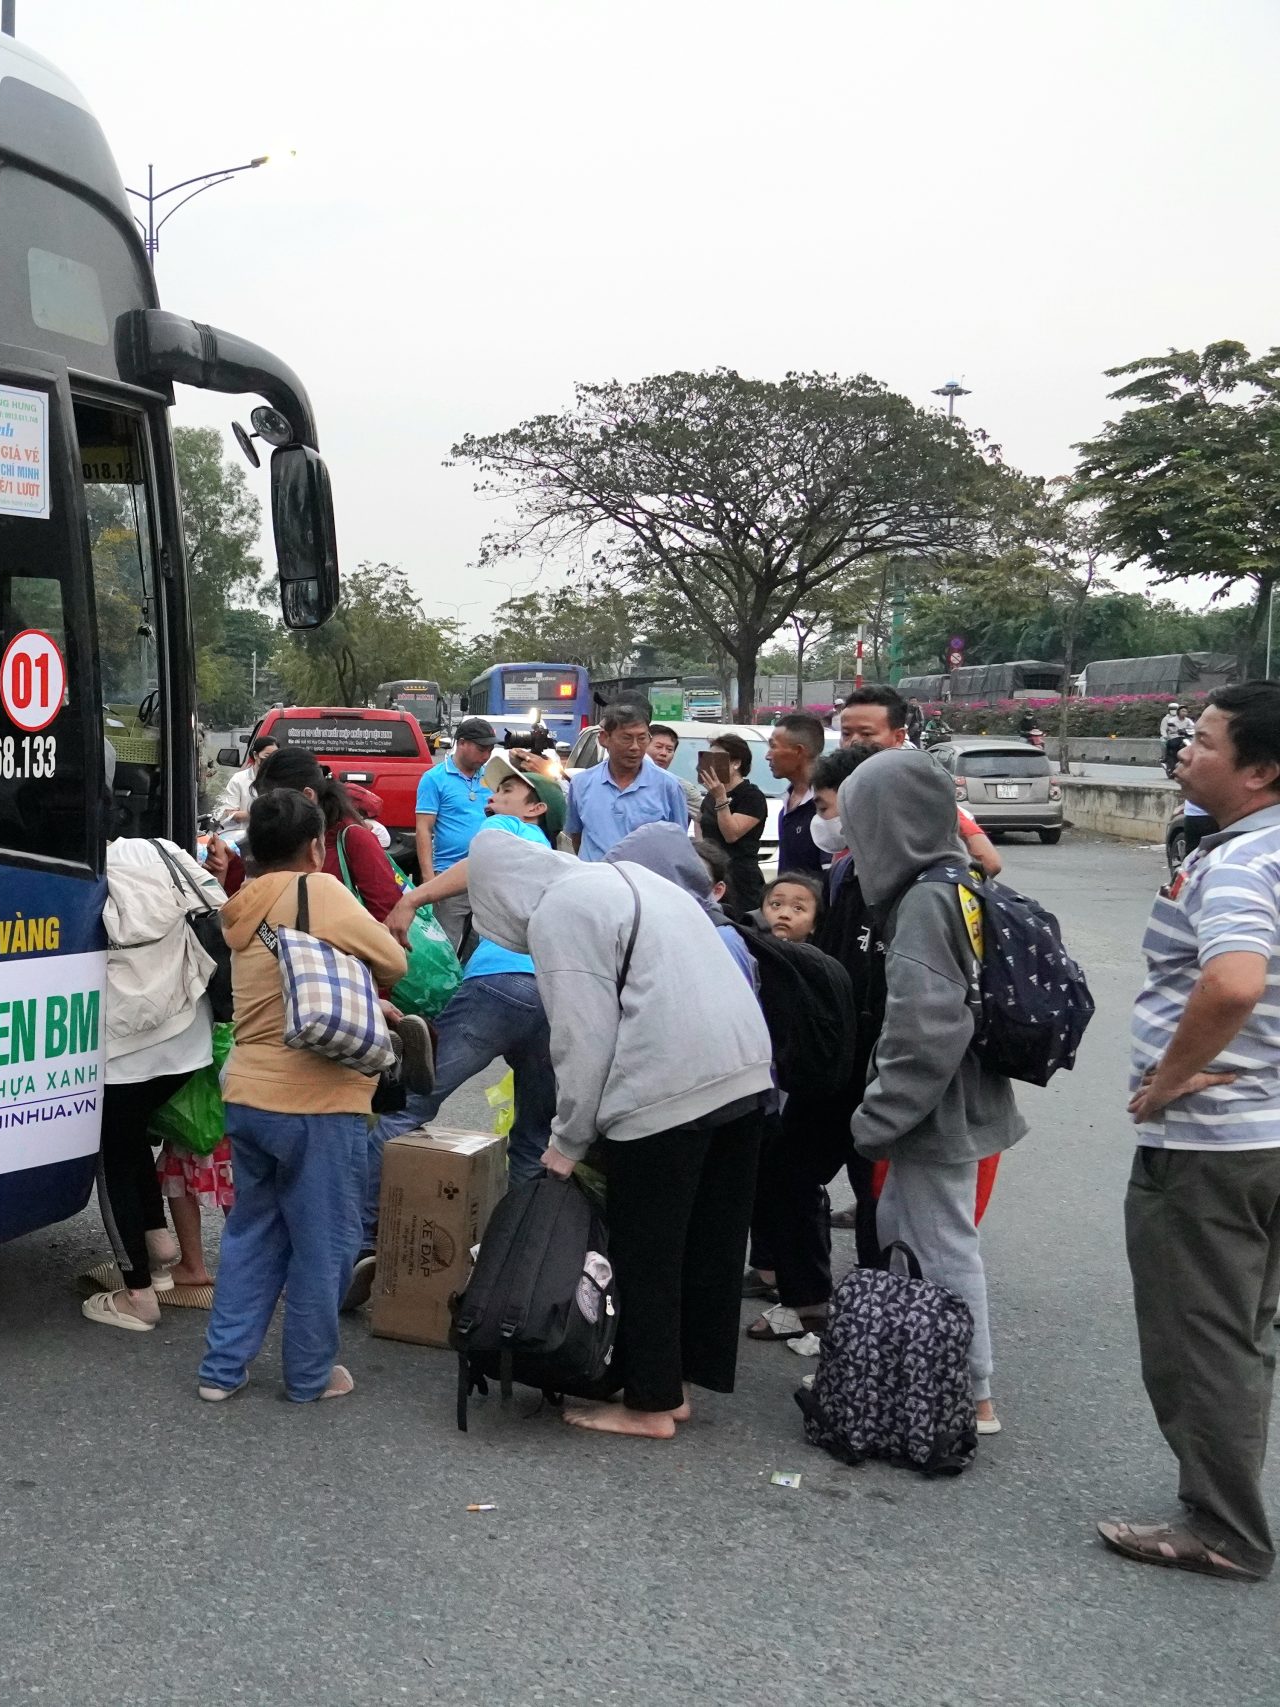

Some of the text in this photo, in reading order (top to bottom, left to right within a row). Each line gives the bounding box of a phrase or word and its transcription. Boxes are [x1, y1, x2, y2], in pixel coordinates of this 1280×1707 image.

[25, 446, 40, 463] VÉ
[17, 466, 40, 480] MINH
[12, 652, 49, 709] 01
[45, 989, 100, 1059] BM
[47, 1064, 98, 1090] XANH
